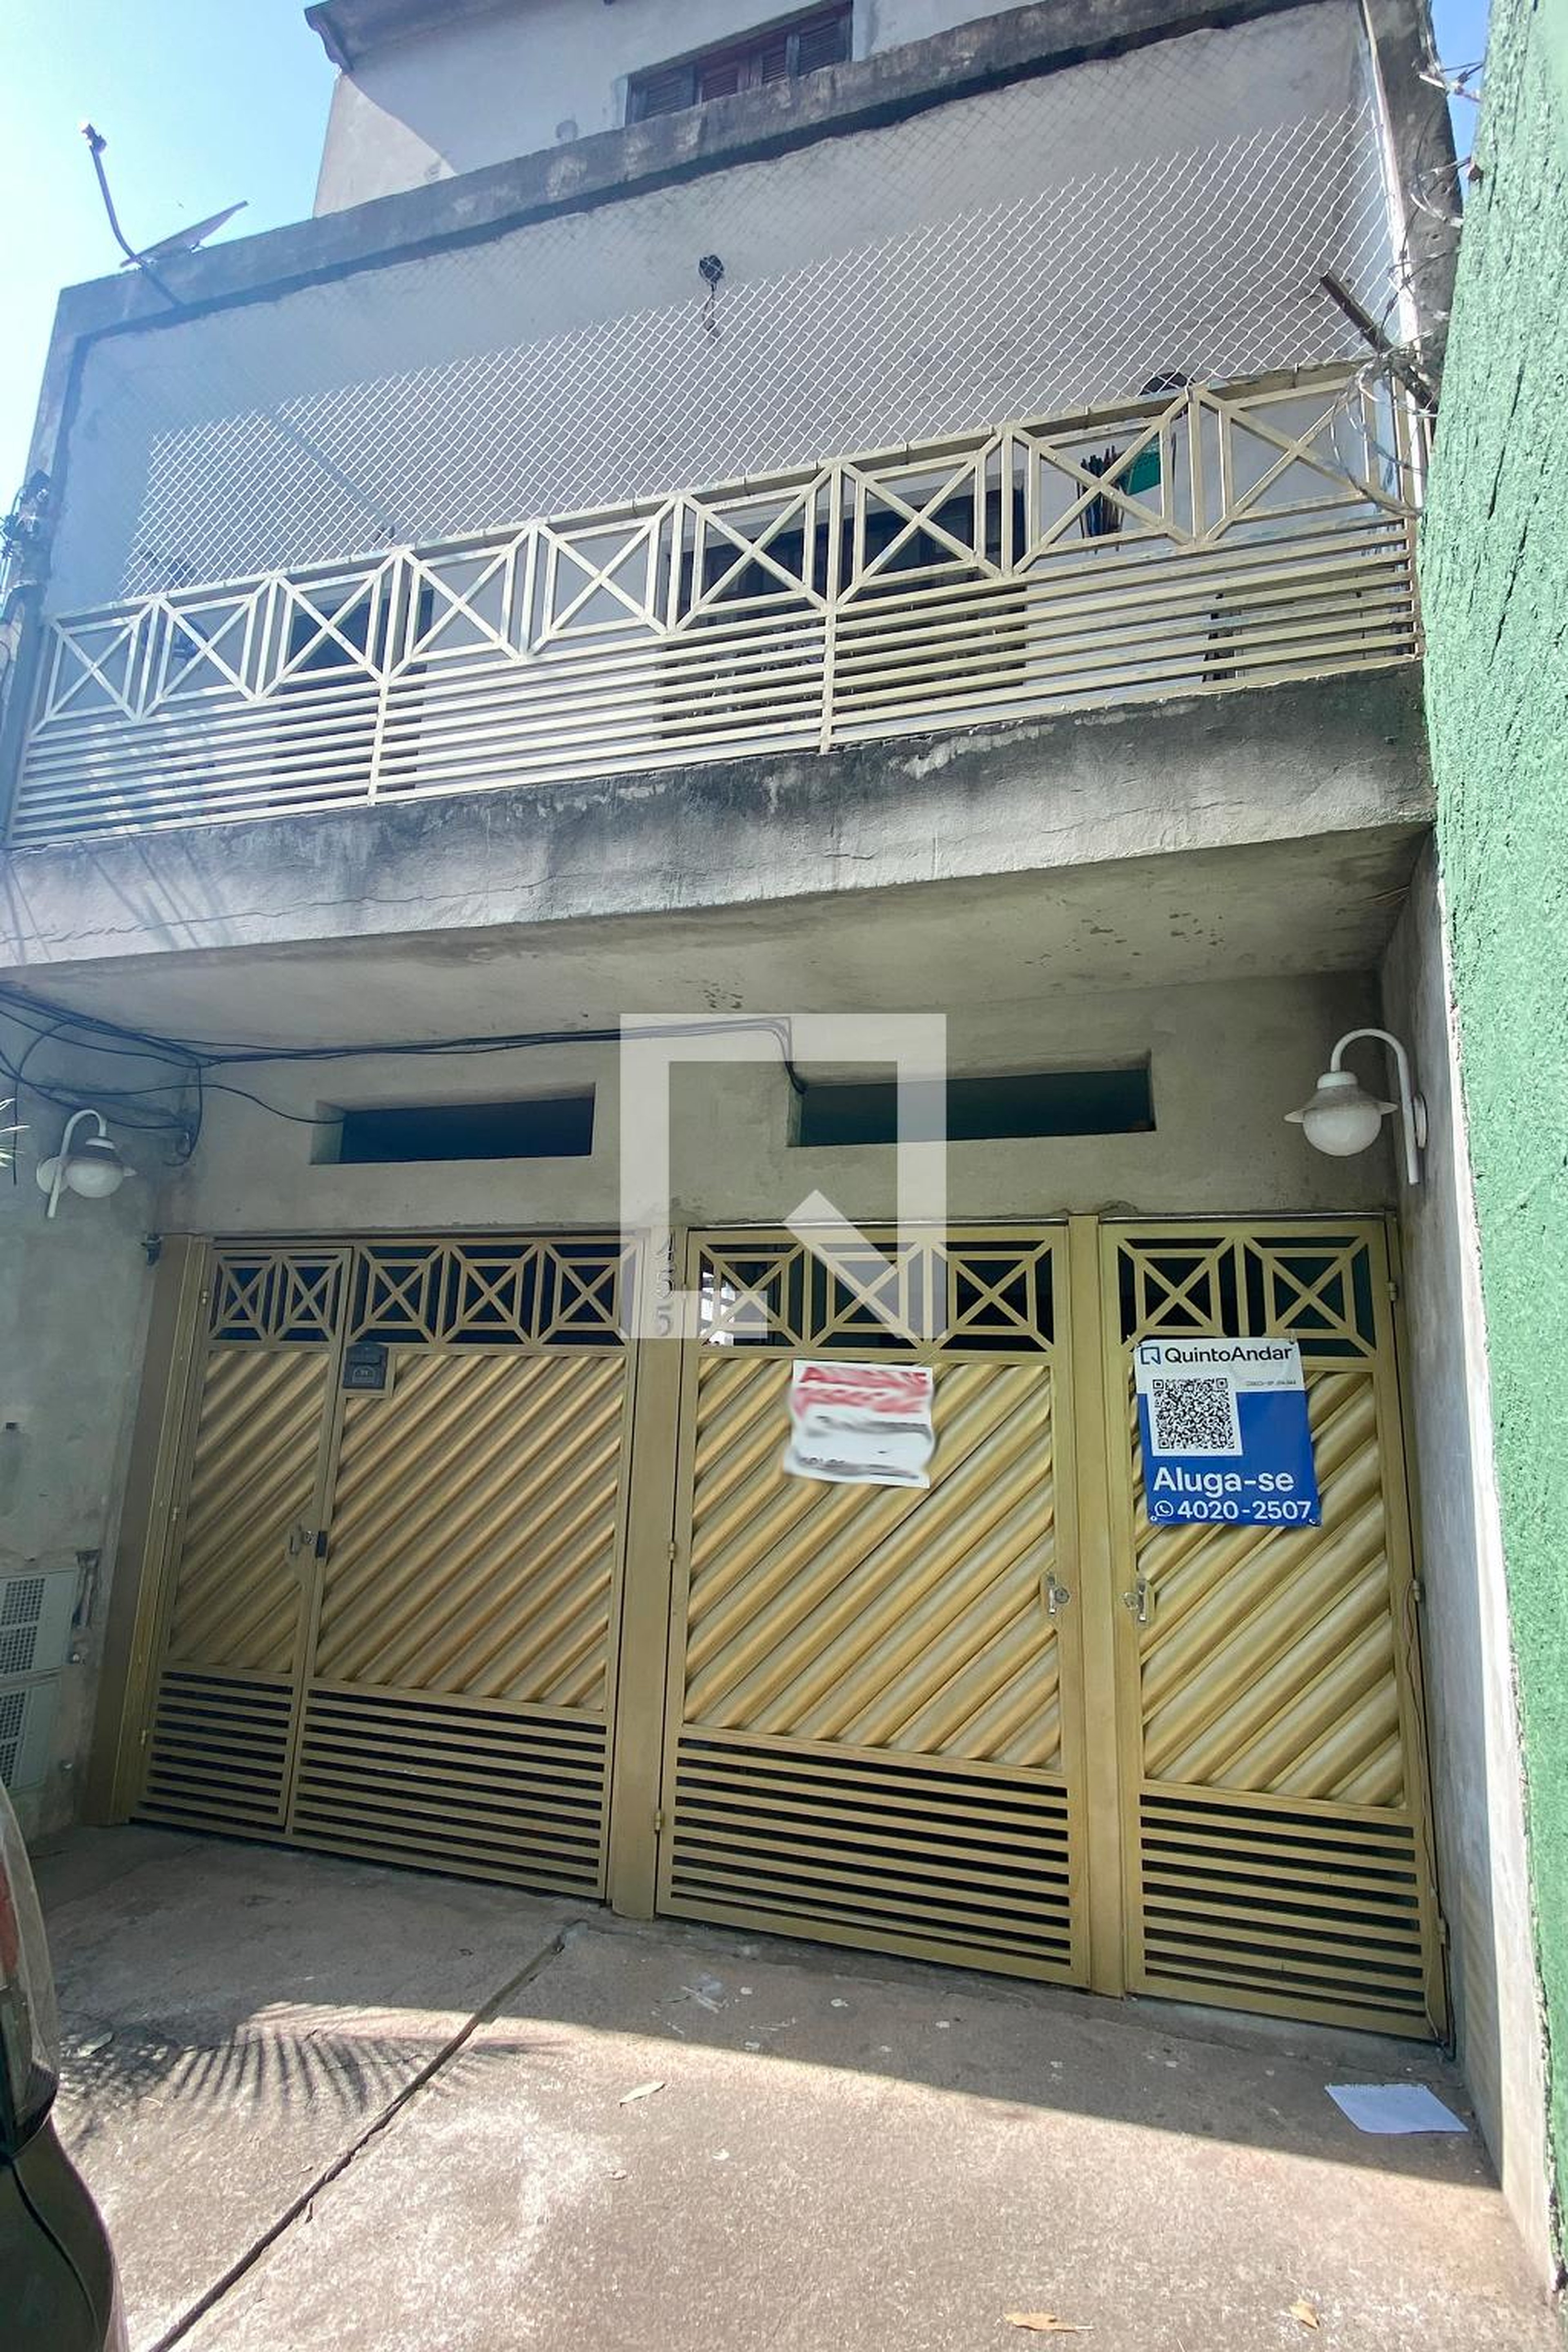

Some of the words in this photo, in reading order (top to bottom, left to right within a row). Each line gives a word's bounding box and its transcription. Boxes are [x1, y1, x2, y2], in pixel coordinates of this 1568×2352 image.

[1165, 1346, 1293, 1363] QuintoAndar
[1153, 1467, 1294, 1498] Aluga-se
[1177, 1500, 1312, 1519] 4020-2507
